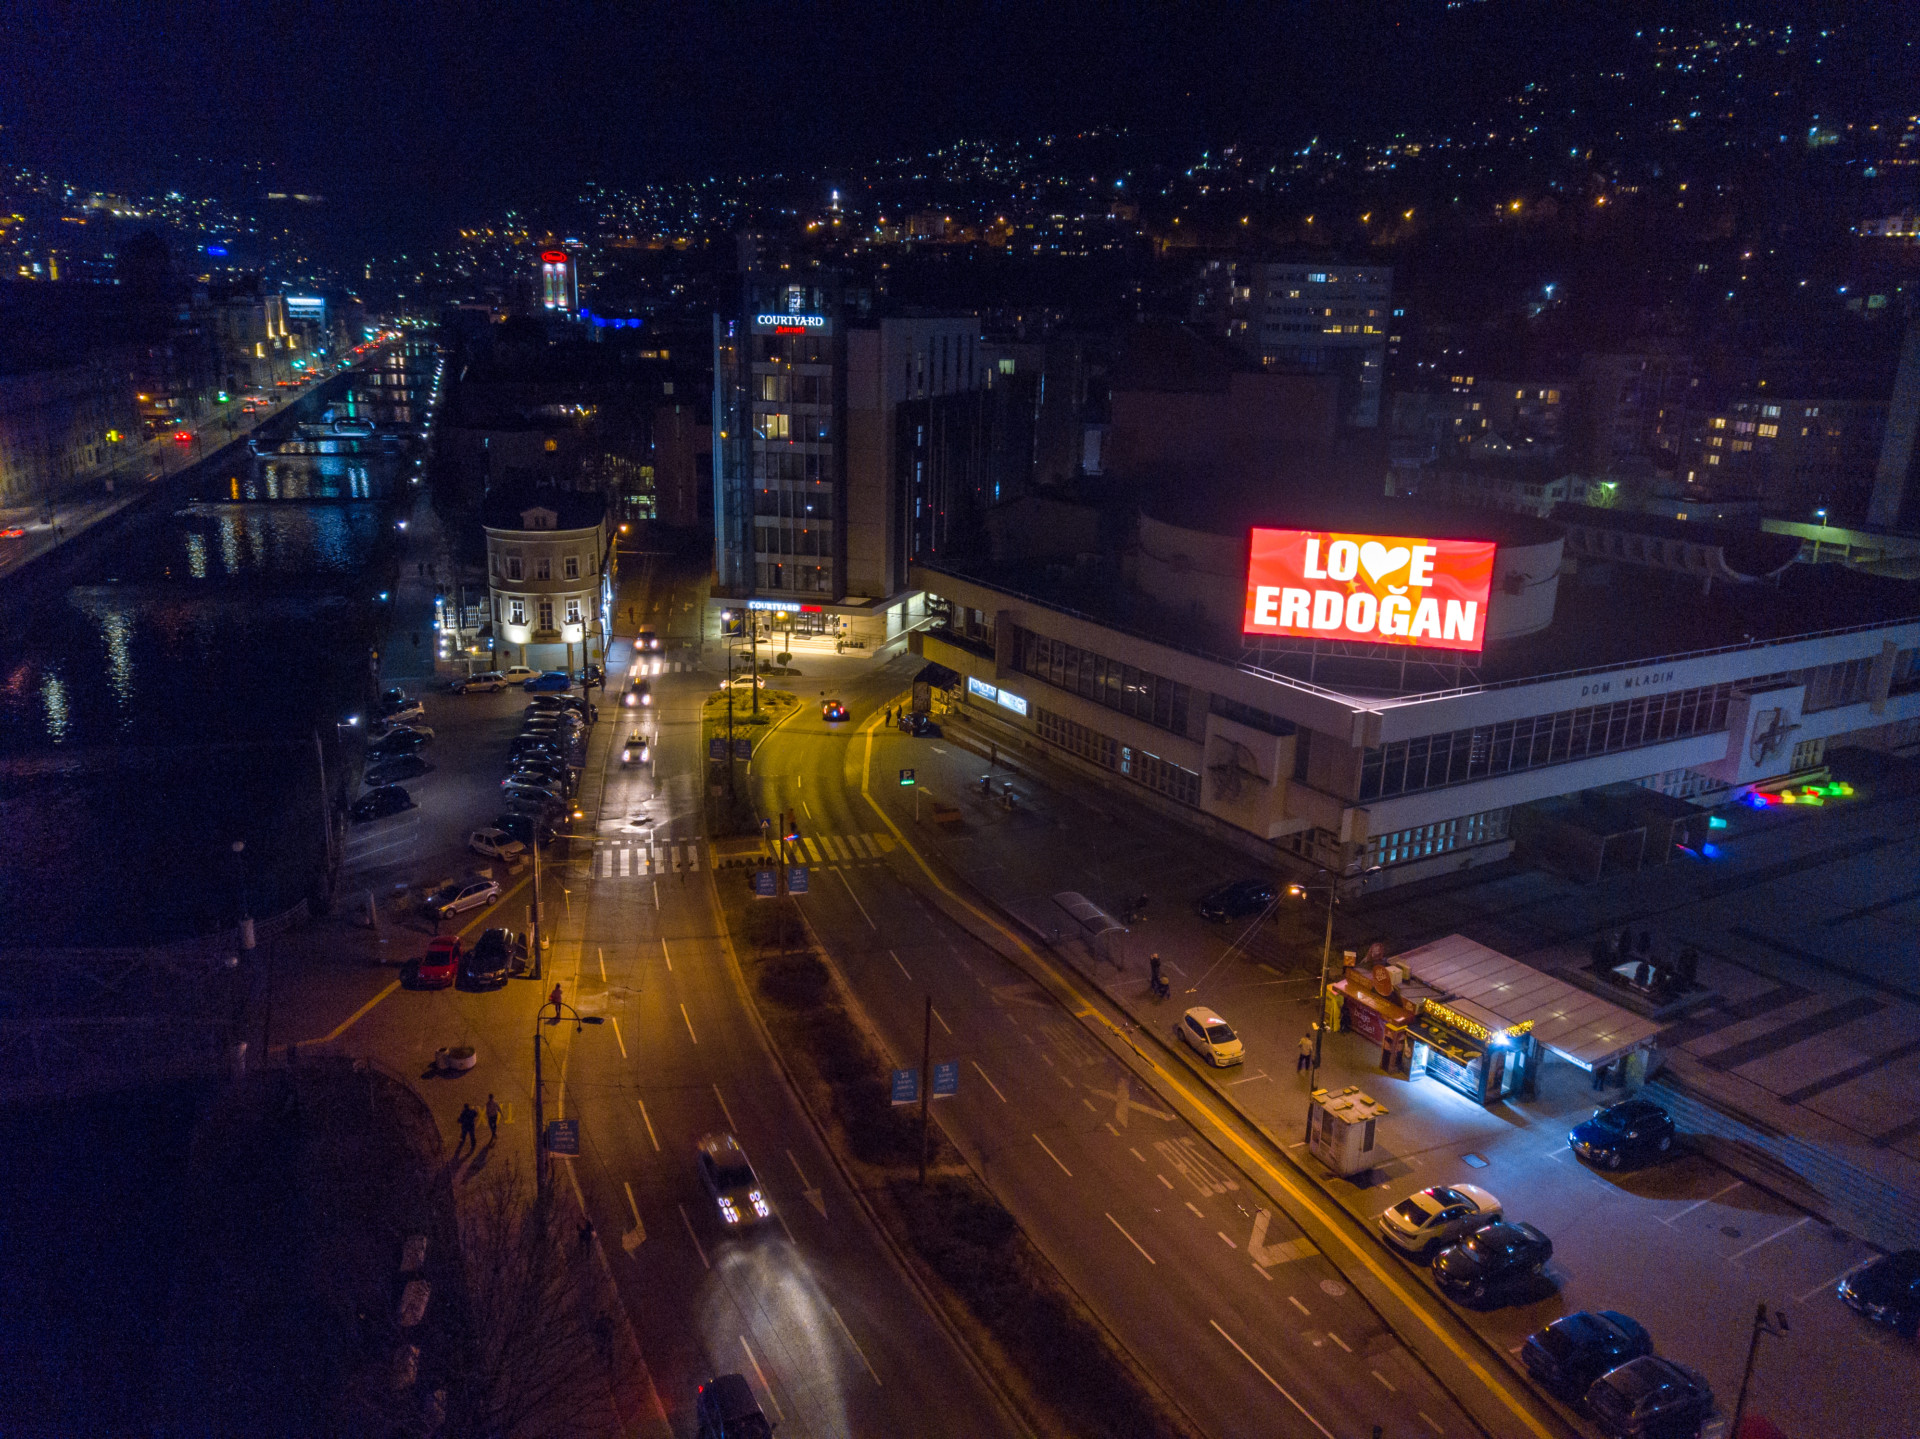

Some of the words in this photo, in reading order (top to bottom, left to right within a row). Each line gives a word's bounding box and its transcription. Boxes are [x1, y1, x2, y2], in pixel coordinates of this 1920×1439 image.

[757, 315, 824, 326] COURTYARD
[749, 601, 800, 611] COURTYARD
[1253, 584, 1478, 642] ERDOĞAN
[1581, 682, 1610, 696] DOM
[1624, 671, 1674, 688] MLADIH
